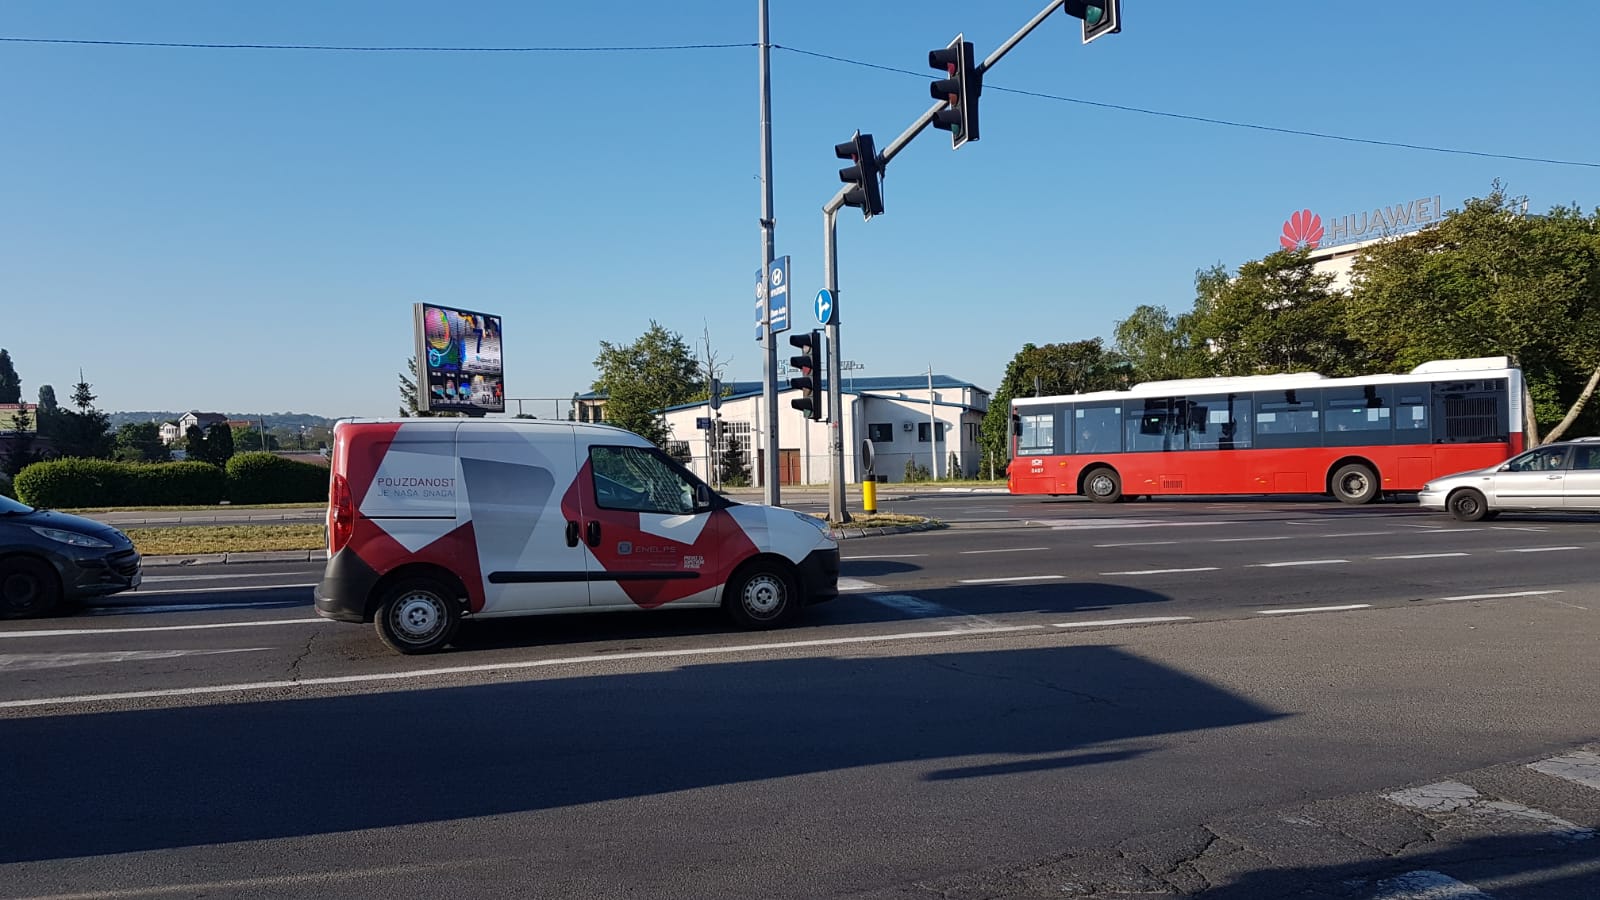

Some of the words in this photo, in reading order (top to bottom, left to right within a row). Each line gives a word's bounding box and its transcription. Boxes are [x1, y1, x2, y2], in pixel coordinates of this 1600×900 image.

[1330, 195, 1441, 240] HUAWEI
[377, 477, 456, 487] POUZDANOST
[377, 489, 389, 497] JE
[394, 488, 418, 497] NAŠA
